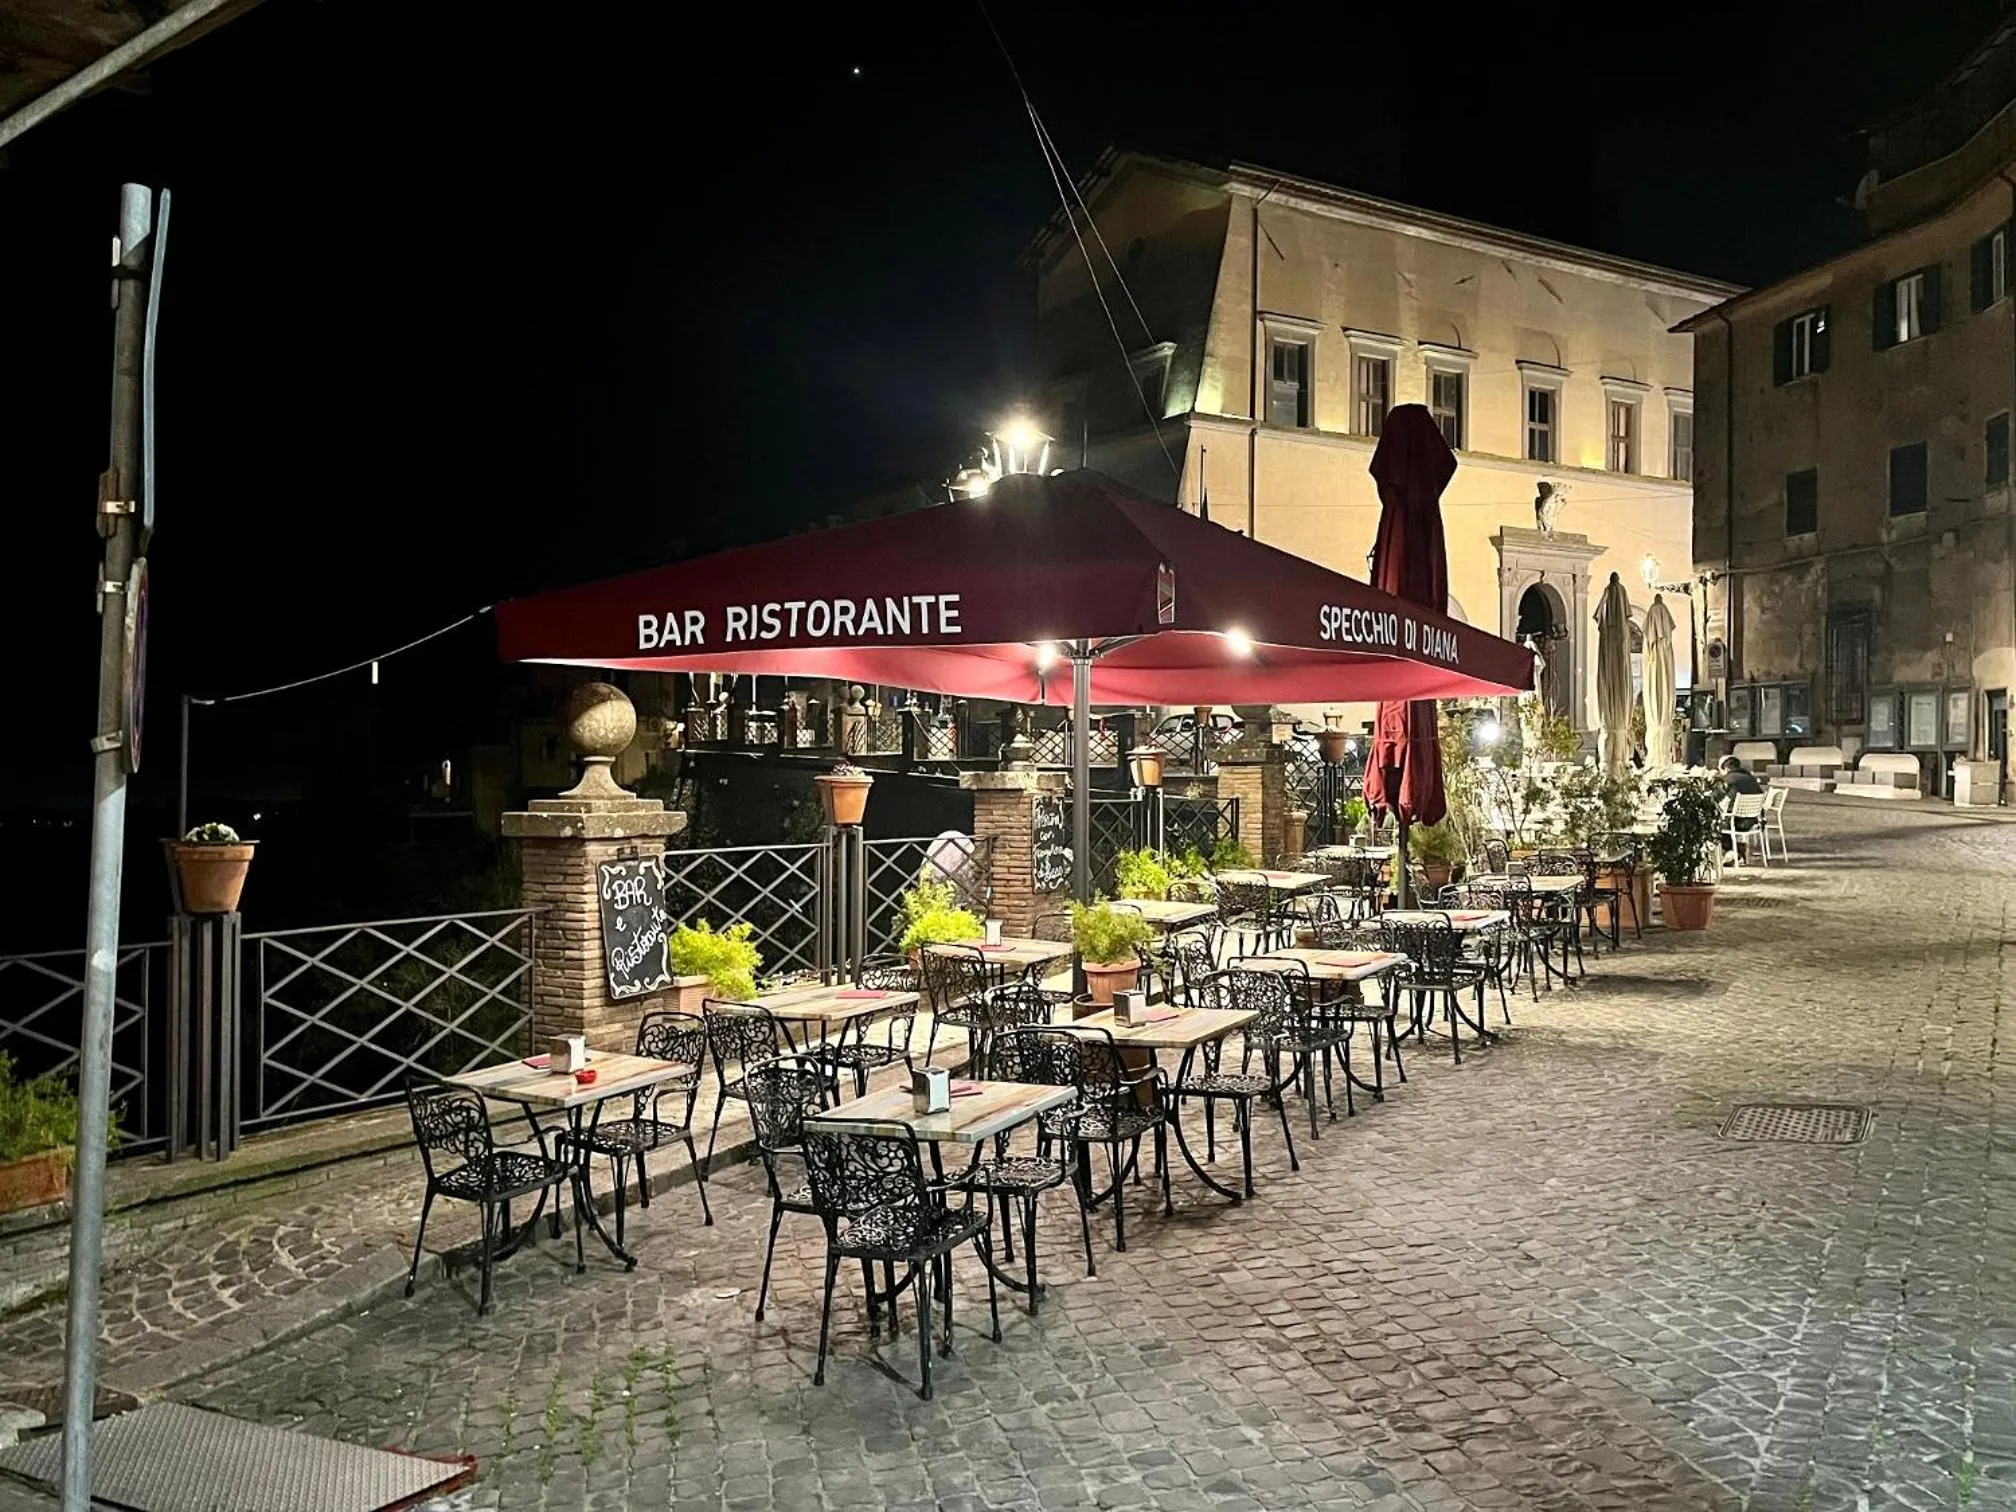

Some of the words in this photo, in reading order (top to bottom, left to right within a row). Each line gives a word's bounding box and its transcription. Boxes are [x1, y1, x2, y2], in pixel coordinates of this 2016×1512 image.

[638, 609, 705, 650] BAR
[725, 593, 962, 642] RISTORANTE
[1319, 604, 1398, 646] SPECCHIO
[1405, 618, 1417, 651] DI
[1422, 624, 1459, 664] DIANA
[611, 876, 653, 910] BAR
[615, 915, 627, 932] e
